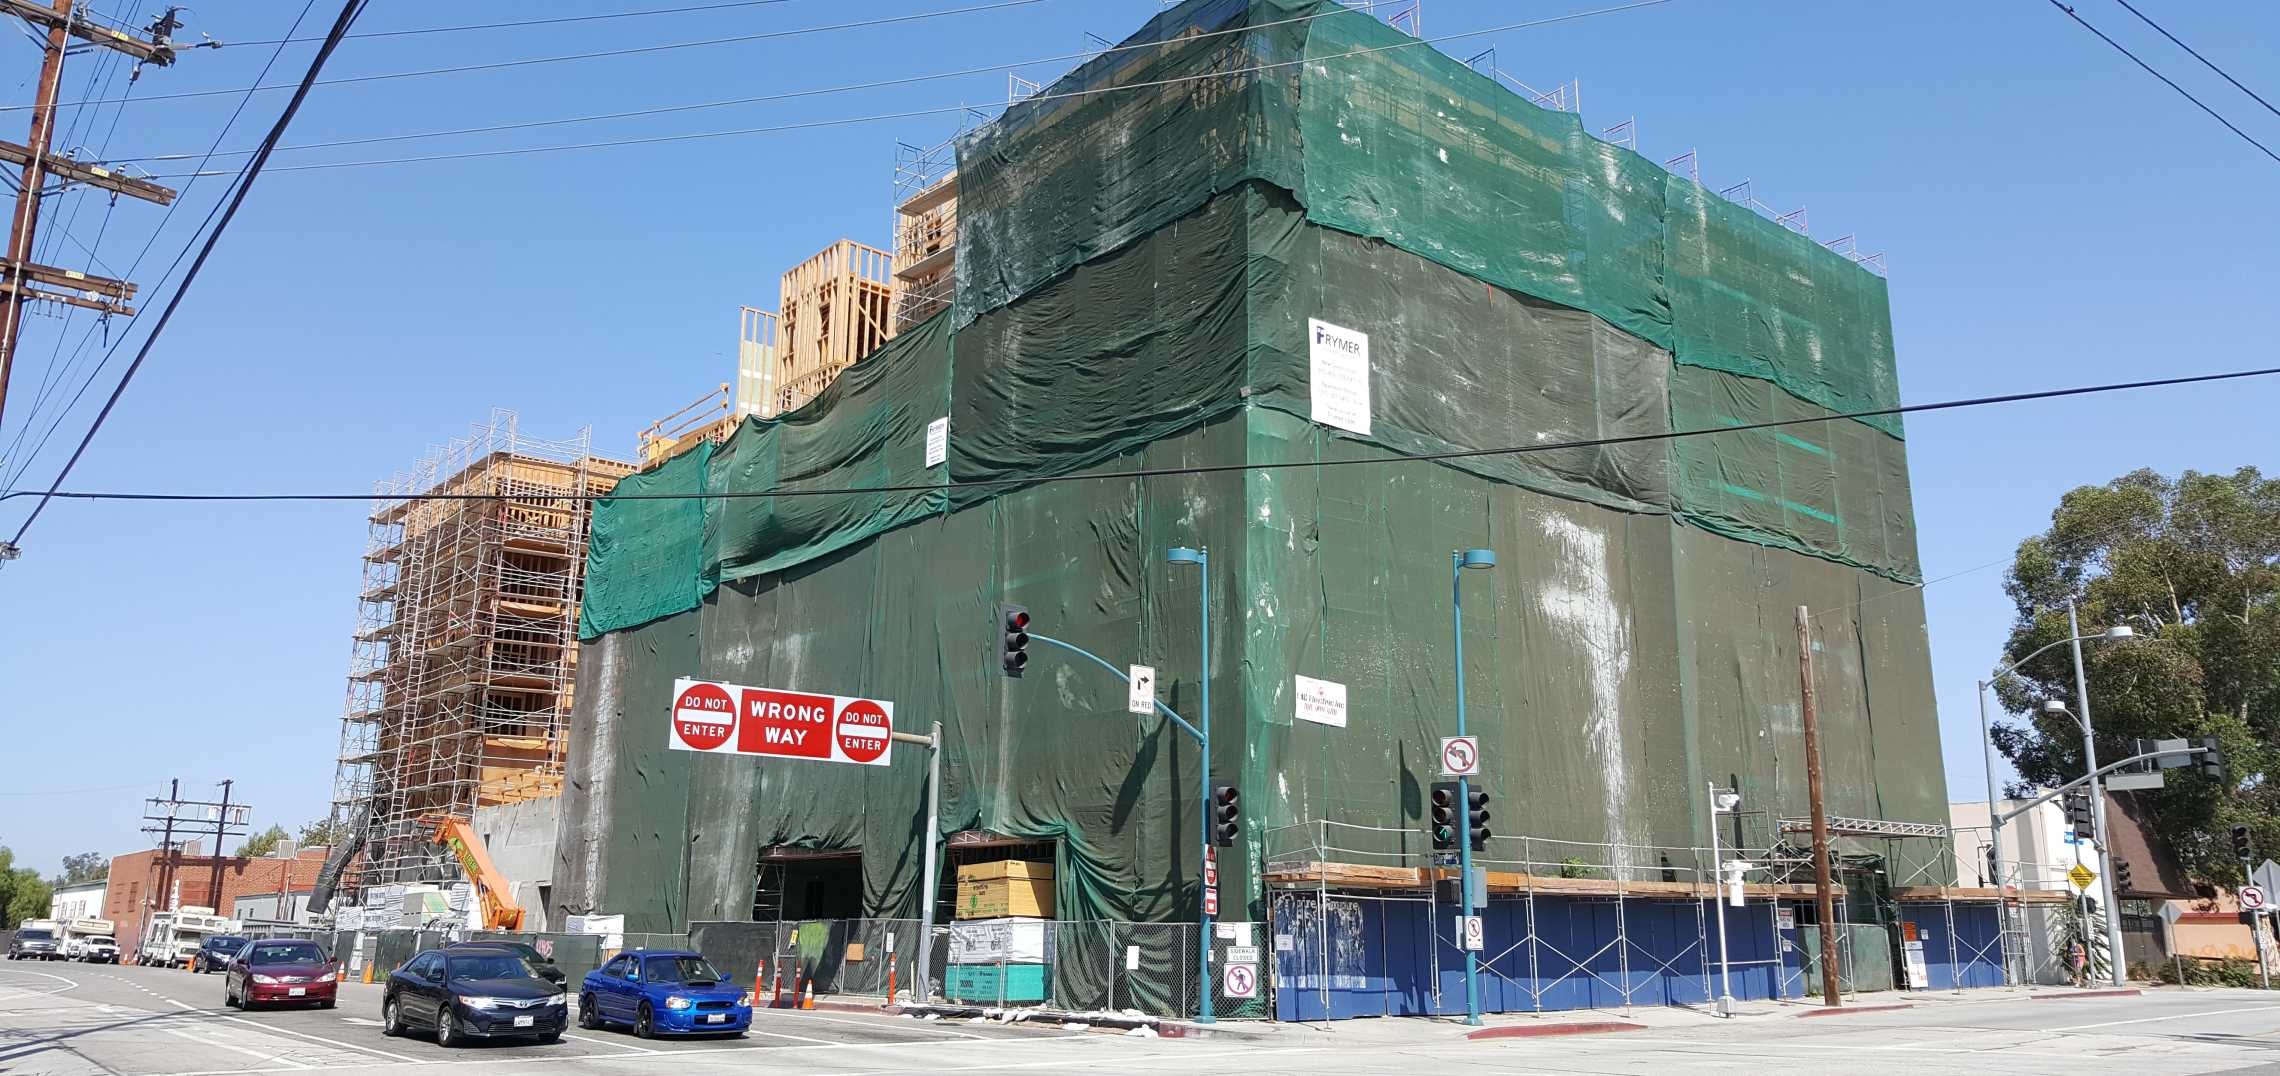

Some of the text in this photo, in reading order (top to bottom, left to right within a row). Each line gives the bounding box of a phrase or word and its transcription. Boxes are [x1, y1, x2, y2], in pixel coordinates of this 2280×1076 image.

[685, 696, 728, 710] DO NOT
[751, 700, 826, 723] WRONG
[846, 711, 882, 725] DO NOT
[683, 723, 725, 737] ENTER
[765, 727, 808, 746] WAY
[845, 737, 881, 751] ENTER
